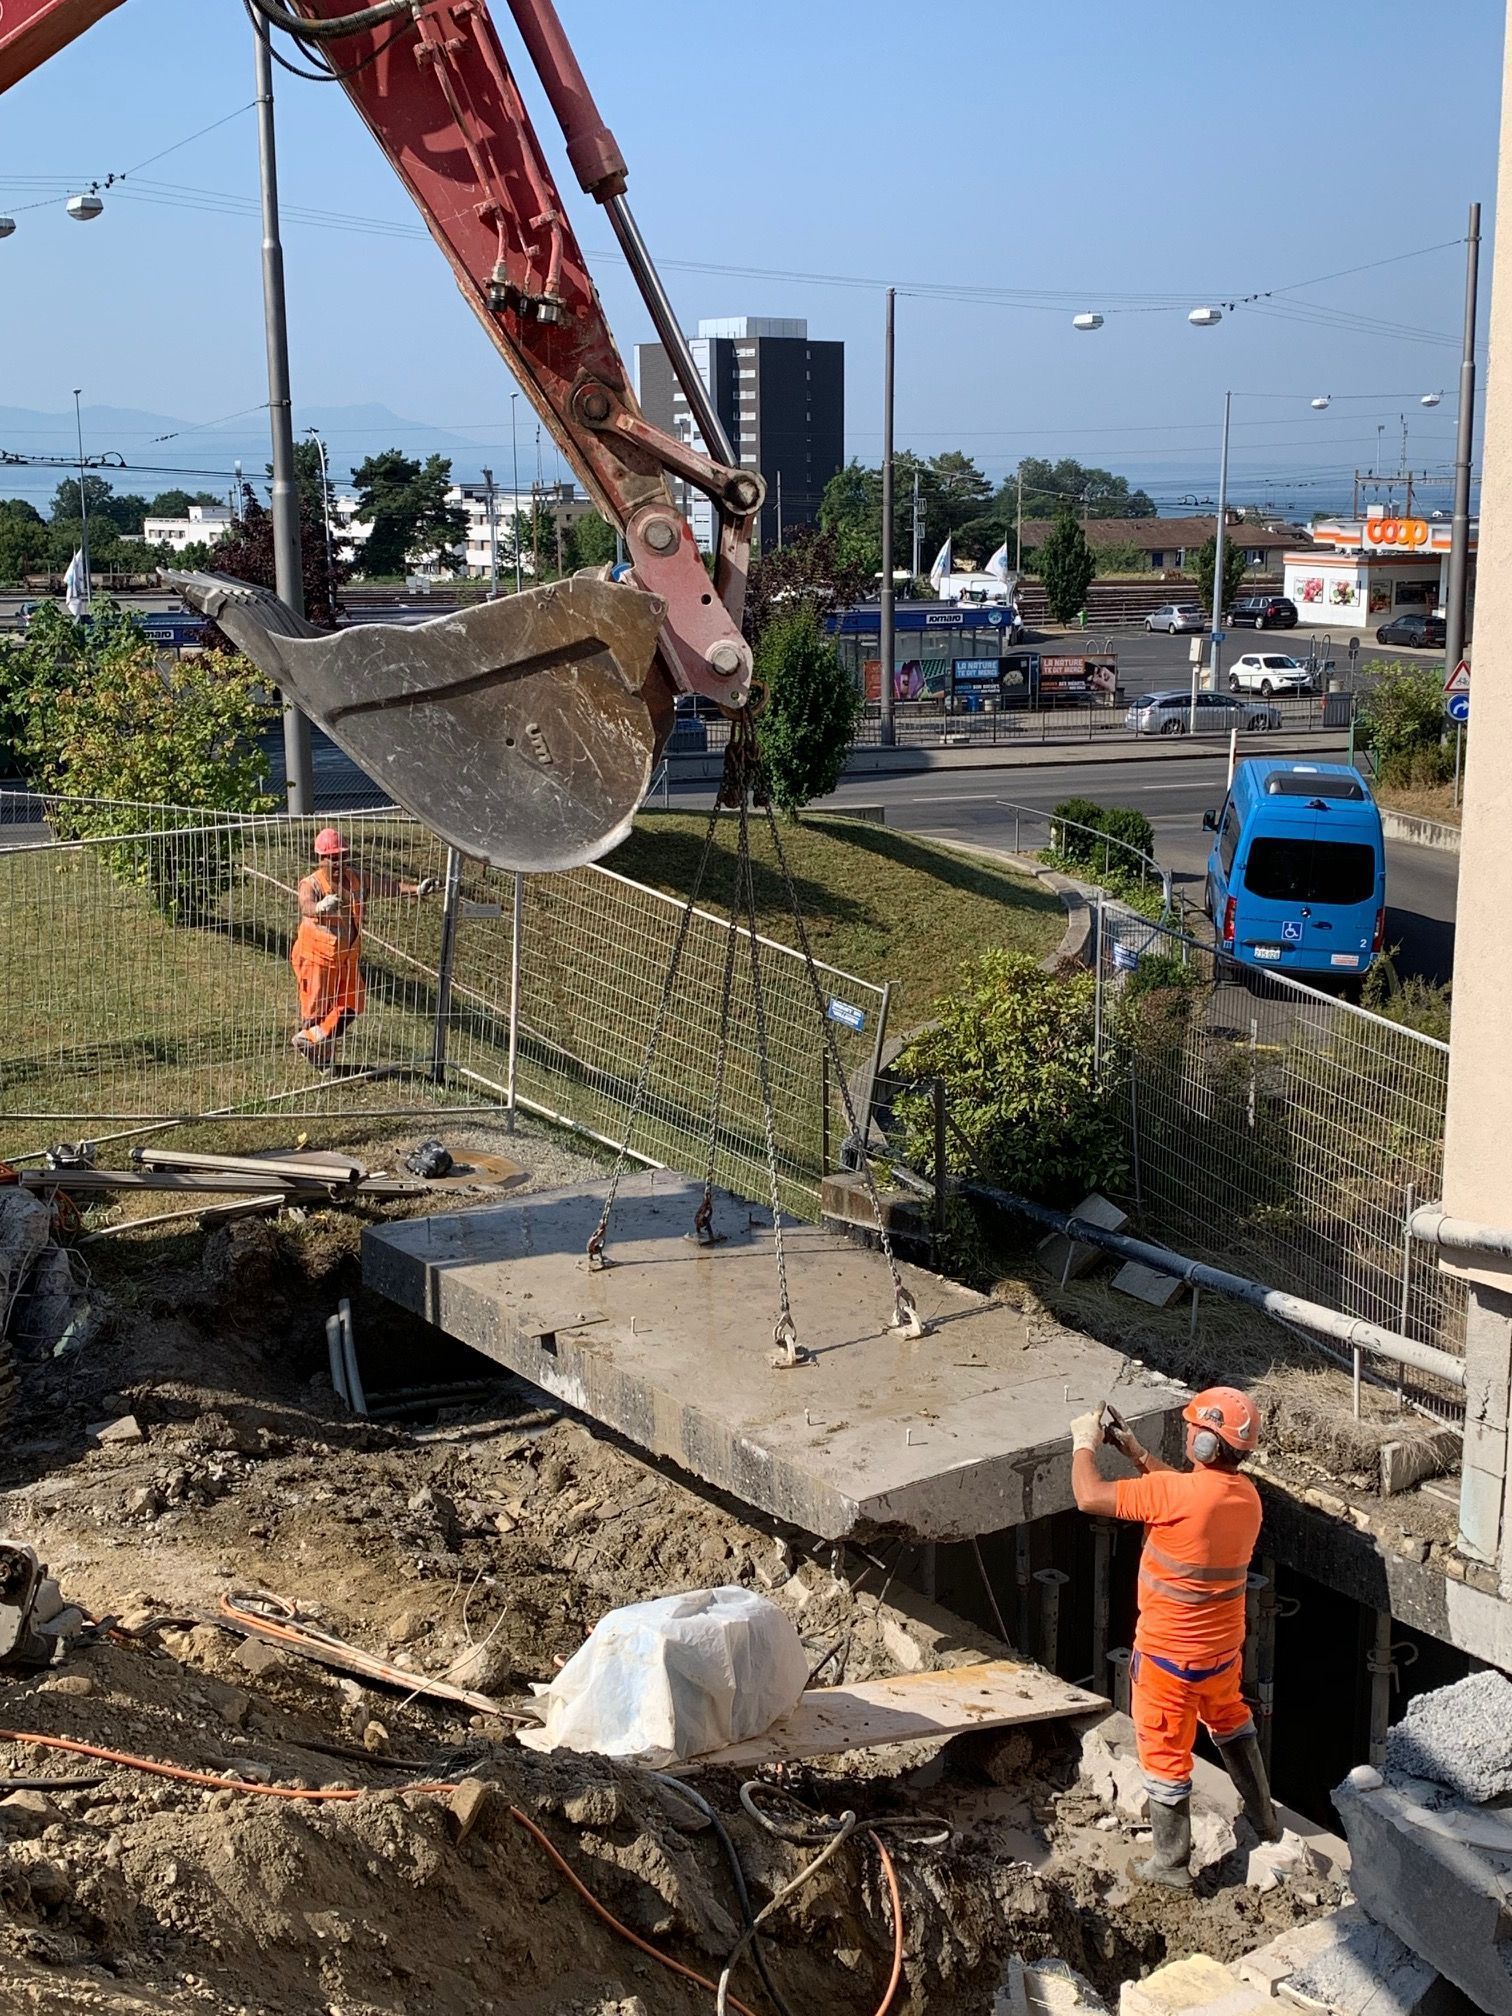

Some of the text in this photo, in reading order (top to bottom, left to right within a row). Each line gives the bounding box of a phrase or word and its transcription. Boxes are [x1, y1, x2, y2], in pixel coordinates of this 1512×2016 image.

[1367, 518, 1428, 551] coop
[1054, 659, 1084, 667] NATURE
[1360, 938, 1368, 949] 2
